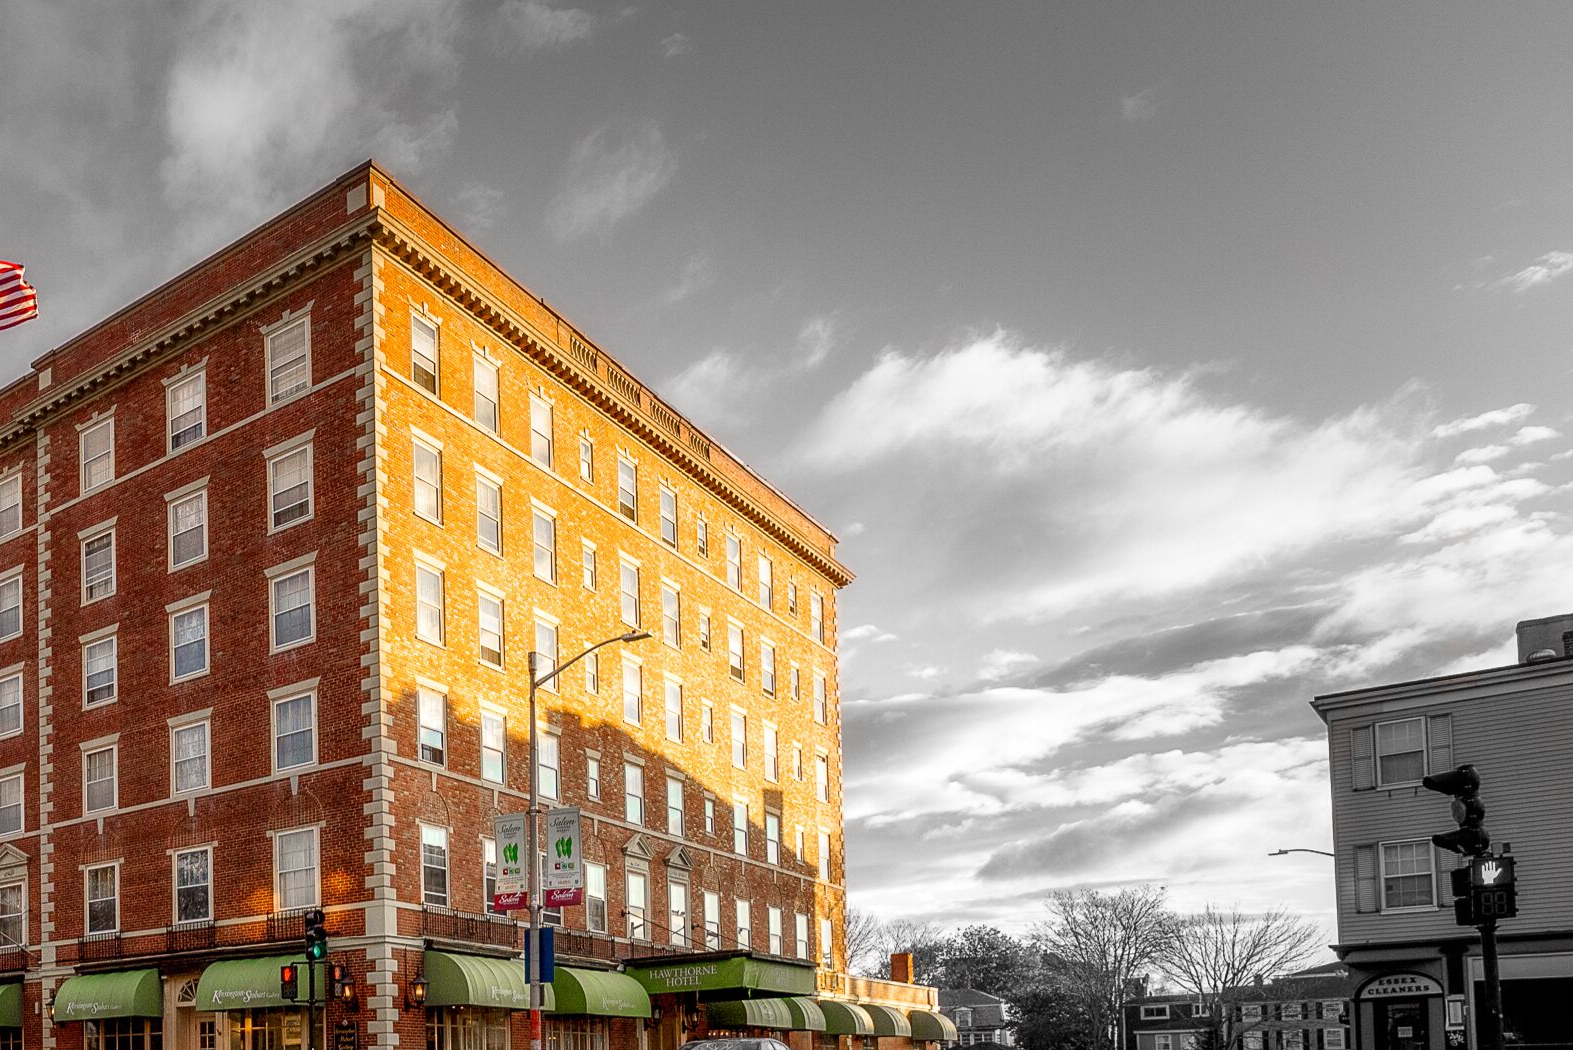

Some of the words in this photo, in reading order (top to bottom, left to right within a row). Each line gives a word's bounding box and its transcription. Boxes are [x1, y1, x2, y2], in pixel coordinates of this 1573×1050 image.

[549, 816, 576, 828] Salem
[497, 823, 522, 835] Salem
[499, 893, 520, 904] Salem
[551, 889, 574, 900] Salem
[649, 965, 717, 980] HAWTHORNE
[666, 975, 701, 987] HOTEL
[1378, 977, 1417, 986] ESSEX
[1368, 984, 1430, 995] CLEANERS
